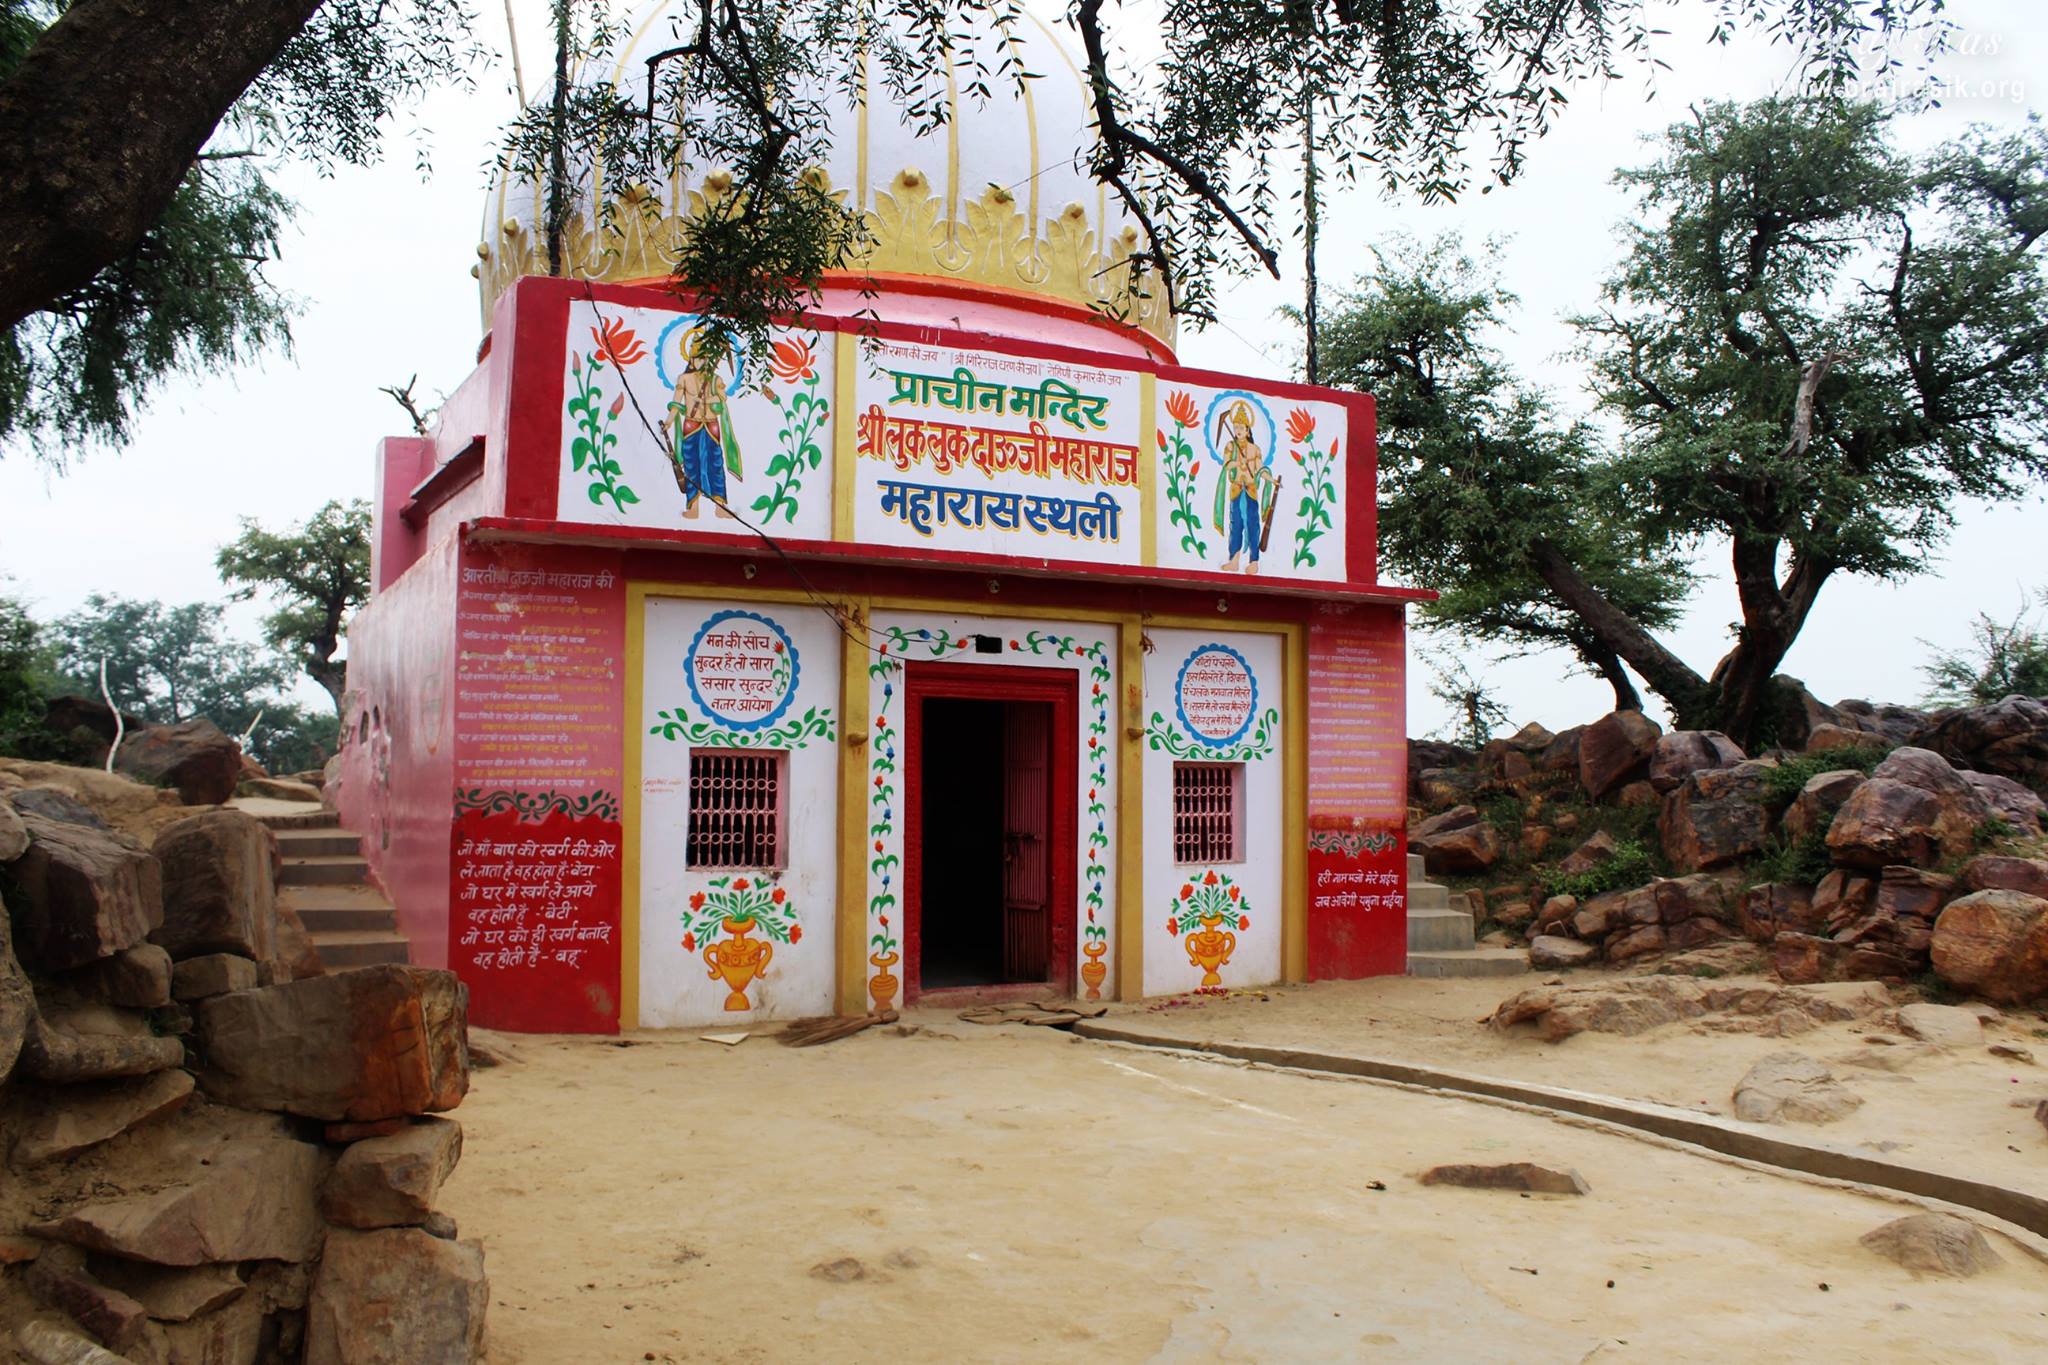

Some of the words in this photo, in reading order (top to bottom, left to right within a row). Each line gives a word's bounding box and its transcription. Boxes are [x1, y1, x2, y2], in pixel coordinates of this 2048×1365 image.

[887, 367, 1008, 414] प्राचीन
[1010, 378, 1110, 430] मन्दिर
[547, 572, 595, 590] महाराज
[595, 569, 616, 590] की
[706, 634, 725, 648] मन
[725, 631, 742, 649] की
[743, 630, 771, 650] सोच
[695, 655, 724, 672] सुन्दर
[734, 653, 748, 670] तो
[749, 657, 775, 671] सारा
[739, 678, 774, 695] सुन्दर
[711, 698, 737, 712] नजर
[737, 696, 774, 712] आयेगा
[457, 839, 475, 857] जो
[518, 840, 540, 857] को
[571, 839, 592, 857] की
[589, 840, 617, 859] ओर
[459, 861, 476, 879] ले
[475, 864, 503, 878] जाता
[503, 860, 515, 881] है
[514, 864, 534, 880] वह
[532, 861, 557, 880] होता
[1317, 869, 1332, 888] हरी
[460, 883, 479, 900] जो
[481, 886, 504, 901] घर
[520, 880, 550, 899] स्वर्ग
[548, 881, 564, 900] ले
[562, 880, 598, 898] आये
[468, 908, 490, 924] वह
[489, 903, 519, 925] होती
[516, 903, 529, 925] है
[460, 926, 481, 945] जो
[484, 930, 506, 945] घर
[508, 926, 530, 942] को
[530, 923, 548, 946] ही
[472, 952, 496, 969] वह
[496, 945, 526, 969] होती
